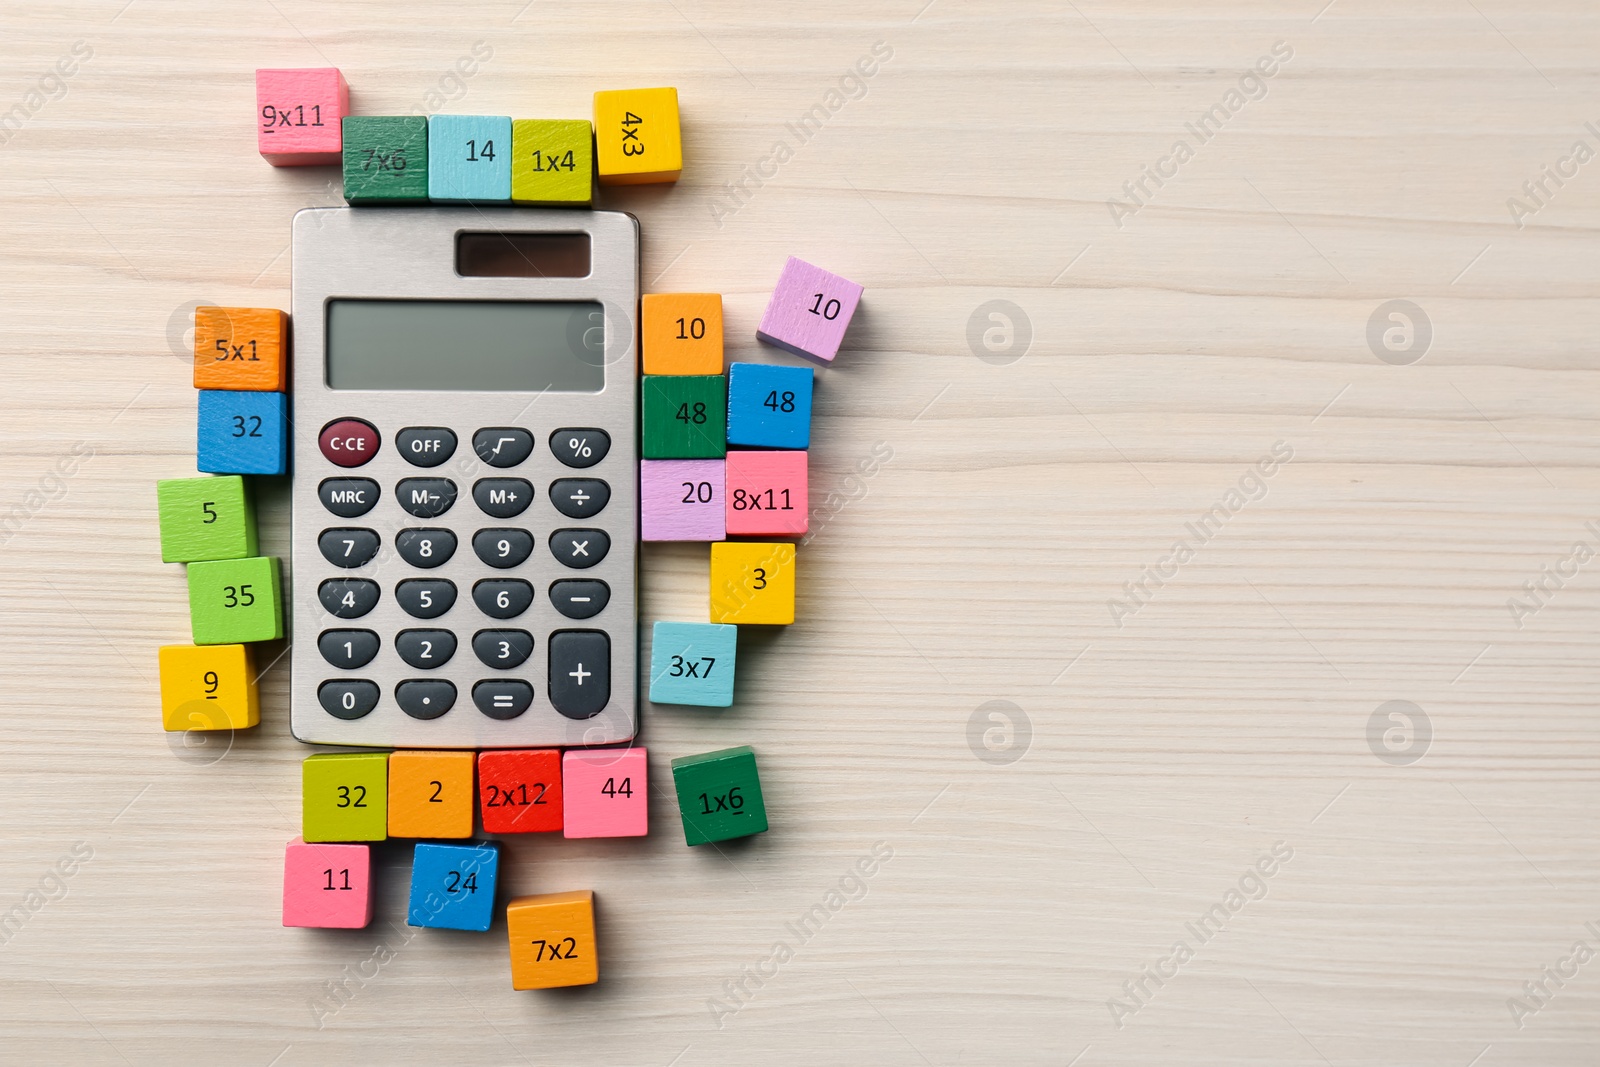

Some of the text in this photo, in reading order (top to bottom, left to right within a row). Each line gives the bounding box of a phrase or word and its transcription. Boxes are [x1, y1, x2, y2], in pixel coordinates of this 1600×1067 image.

[621, 111, 645, 157] 4x3
[466, 139, 496, 162] 14
[532, 150, 576, 172] 1x4
[808, 293, 841, 321] 10
[676, 317, 706, 340] 10
[215, 339, 260, 362] 5x1
[763, 390, 795, 413] 48
[675, 402, 707, 425] 48
[232, 415, 263, 438] 32
[411, 439, 441, 453] OFF
[569, 438, 592, 458] %
[331, 490, 365, 504] MRC
[490, 489, 518, 504] M+
[681, 481, 713, 504] 20
[732, 488, 794, 511] 8x11
[203, 501, 217, 524] 5
[342, 539, 355, 557] 7
[419, 539, 433, 557] 8
[497, 539, 510, 557] 9
[753, 568, 767, 590] 3
[223, 584, 255, 608] 35
[341, 590, 356, 608] 4
[420, 590, 432, 608] 5
[496, 590, 510, 609] 6
[343, 641, 352, 659] 1
[420, 640, 432, 659] 2
[497, 641, 510, 659] 3
[669, 655, 716, 679] 3x7
[203, 671, 219, 700] 9
[342, 691, 356, 710] 0
[336, 785, 368, 808] 32
[429, 780, 443, 803] 2
[486, 782, 547, 808] 2x12
[601, 777, 634, 799] 44
[323, 868, 353, 891] 11
[446, 870, 478, 894] 24
[531, 937, 579, 962] 7x2
